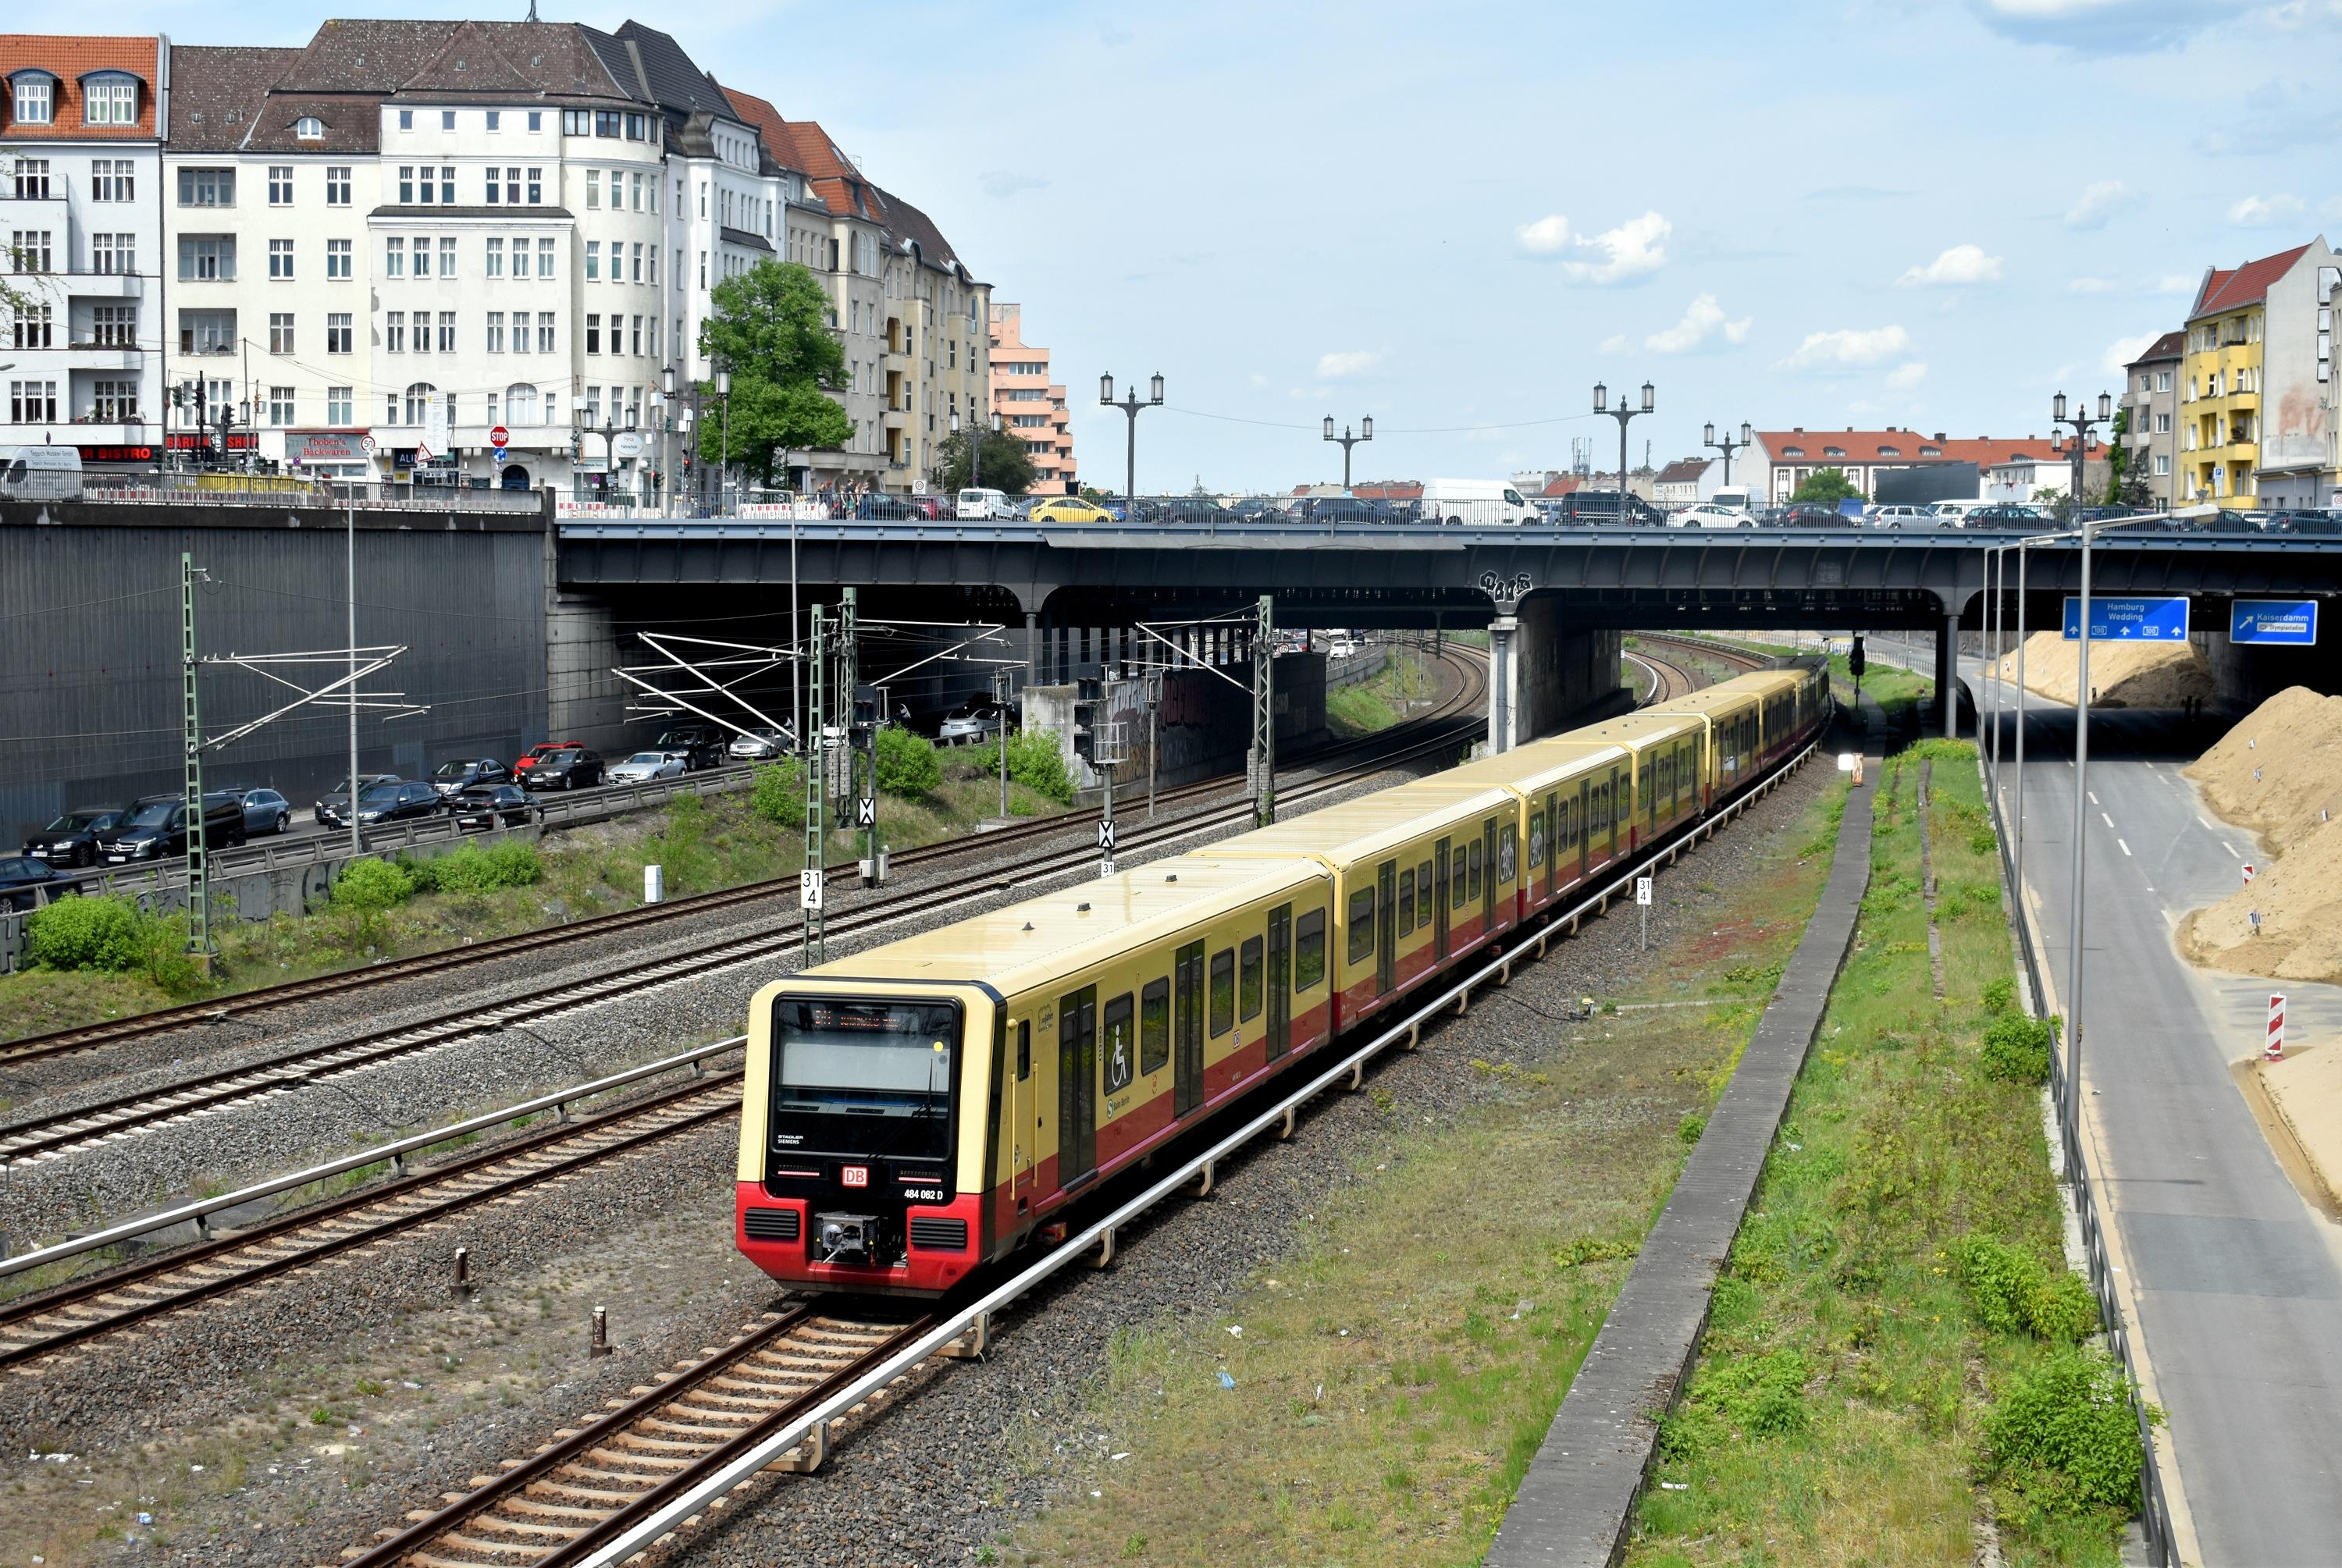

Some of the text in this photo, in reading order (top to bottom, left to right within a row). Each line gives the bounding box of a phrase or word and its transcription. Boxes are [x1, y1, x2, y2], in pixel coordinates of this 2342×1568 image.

[227, 435, 258, 448] SHOP
[307, 437, 346, 446] Thoben's
[491, 432, 508, 442] STOP
[98, 447, 151, 460] BISTRO
[2107, 603, 2144, 612] Hamburg
[2109, 613, 2144, 622] Wedding
[2257, 613, 2309, 622] Kaiserdamm
[1103, 863, 1112, 873] 31
[803, 872, 820, 887] 31
[1639, 880, 1650, 890] 31
[807, 889, 817, 904] 4
[1640, 891, 1646, 901] 4
[1108, 1100, 1113, 1118] S
[845, 1169, 865, 1183] DB
[904, 1189, 943, 1200] 484 062 D
